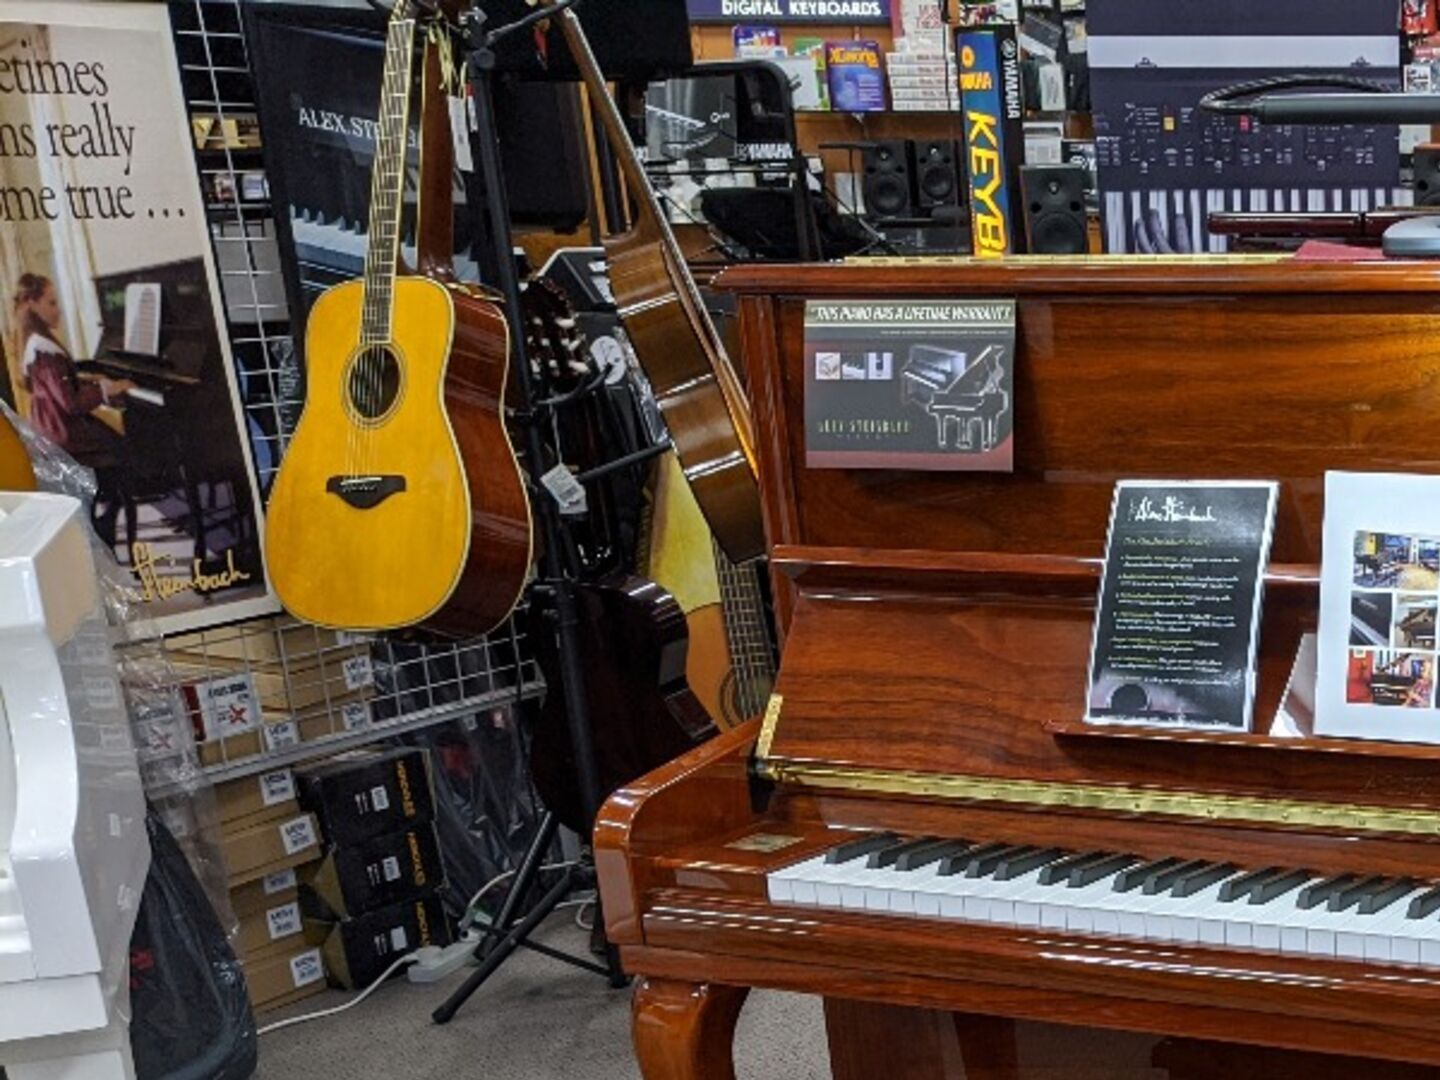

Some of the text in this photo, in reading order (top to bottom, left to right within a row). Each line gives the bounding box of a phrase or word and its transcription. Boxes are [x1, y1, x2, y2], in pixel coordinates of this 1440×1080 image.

[721, 0, 881, 16] DIGITAL KEYBOARDS
[45, 100, 135, 176] really
[65, 181, 135, 220] true
[966, 110, 1008, 259] KEYB
